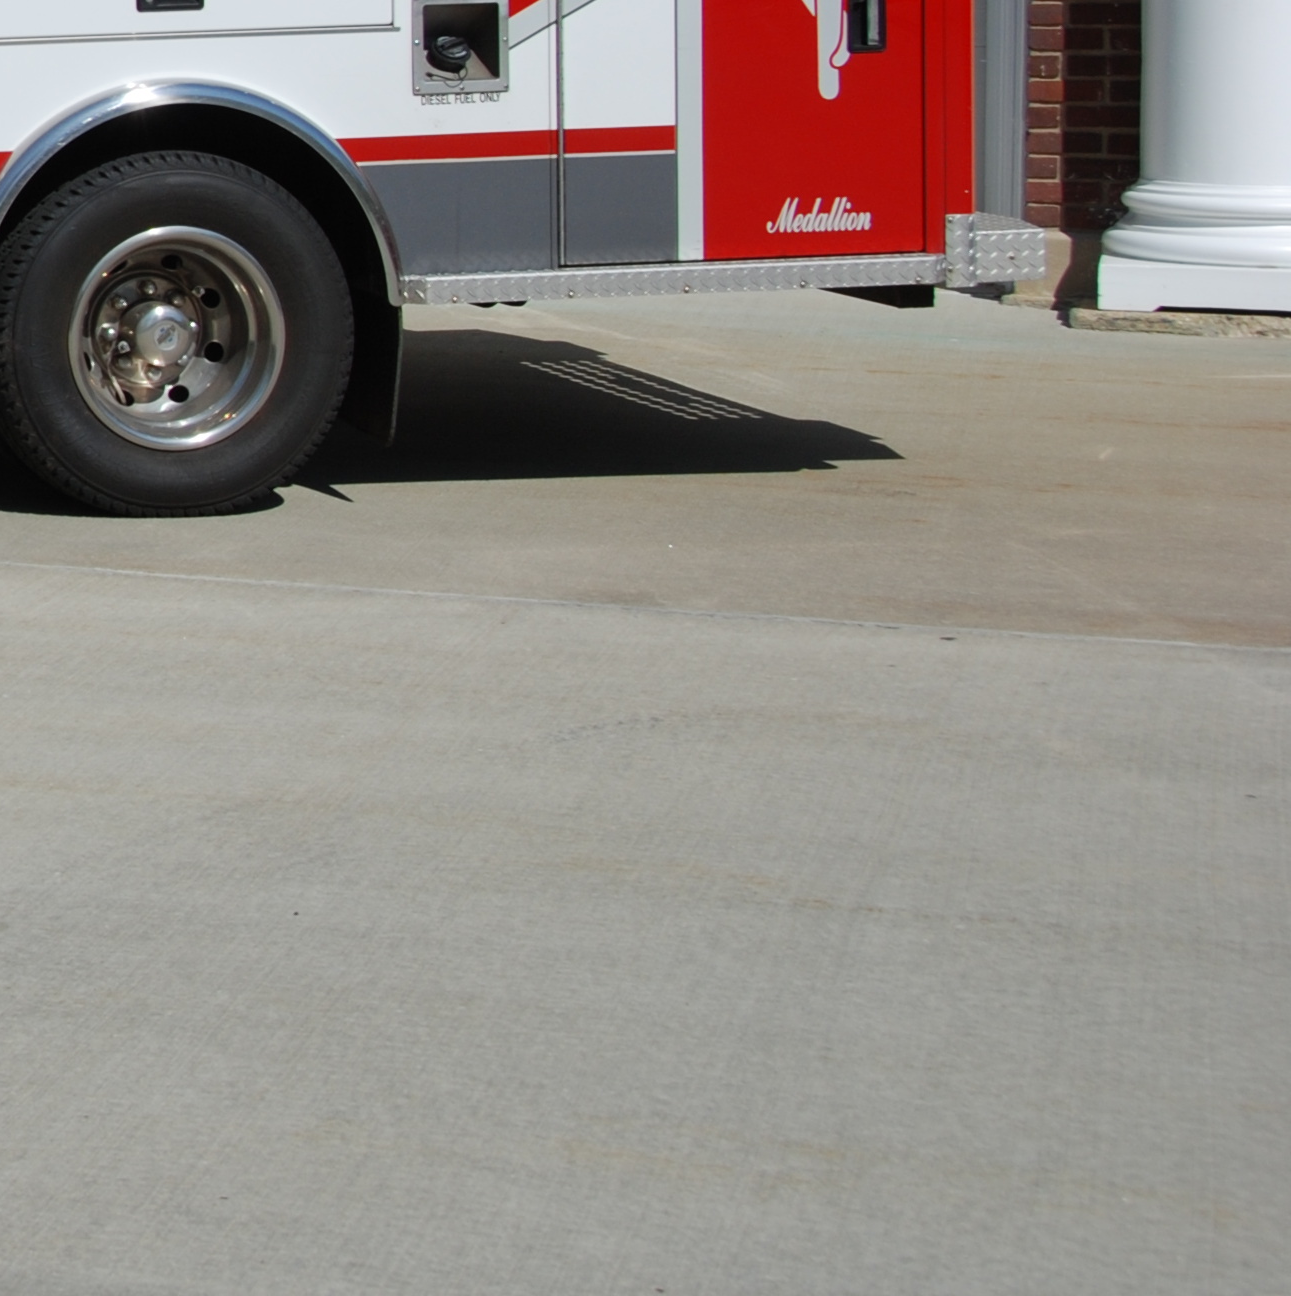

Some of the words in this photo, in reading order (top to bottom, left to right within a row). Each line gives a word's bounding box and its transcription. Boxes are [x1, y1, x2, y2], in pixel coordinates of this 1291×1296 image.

[421, 93, 451, 105] DIESEL
[454, 92, 476, 104] FUEL
[479, 91, 501, 103] ONLY
[766, 196, 872, 234] Medallion
